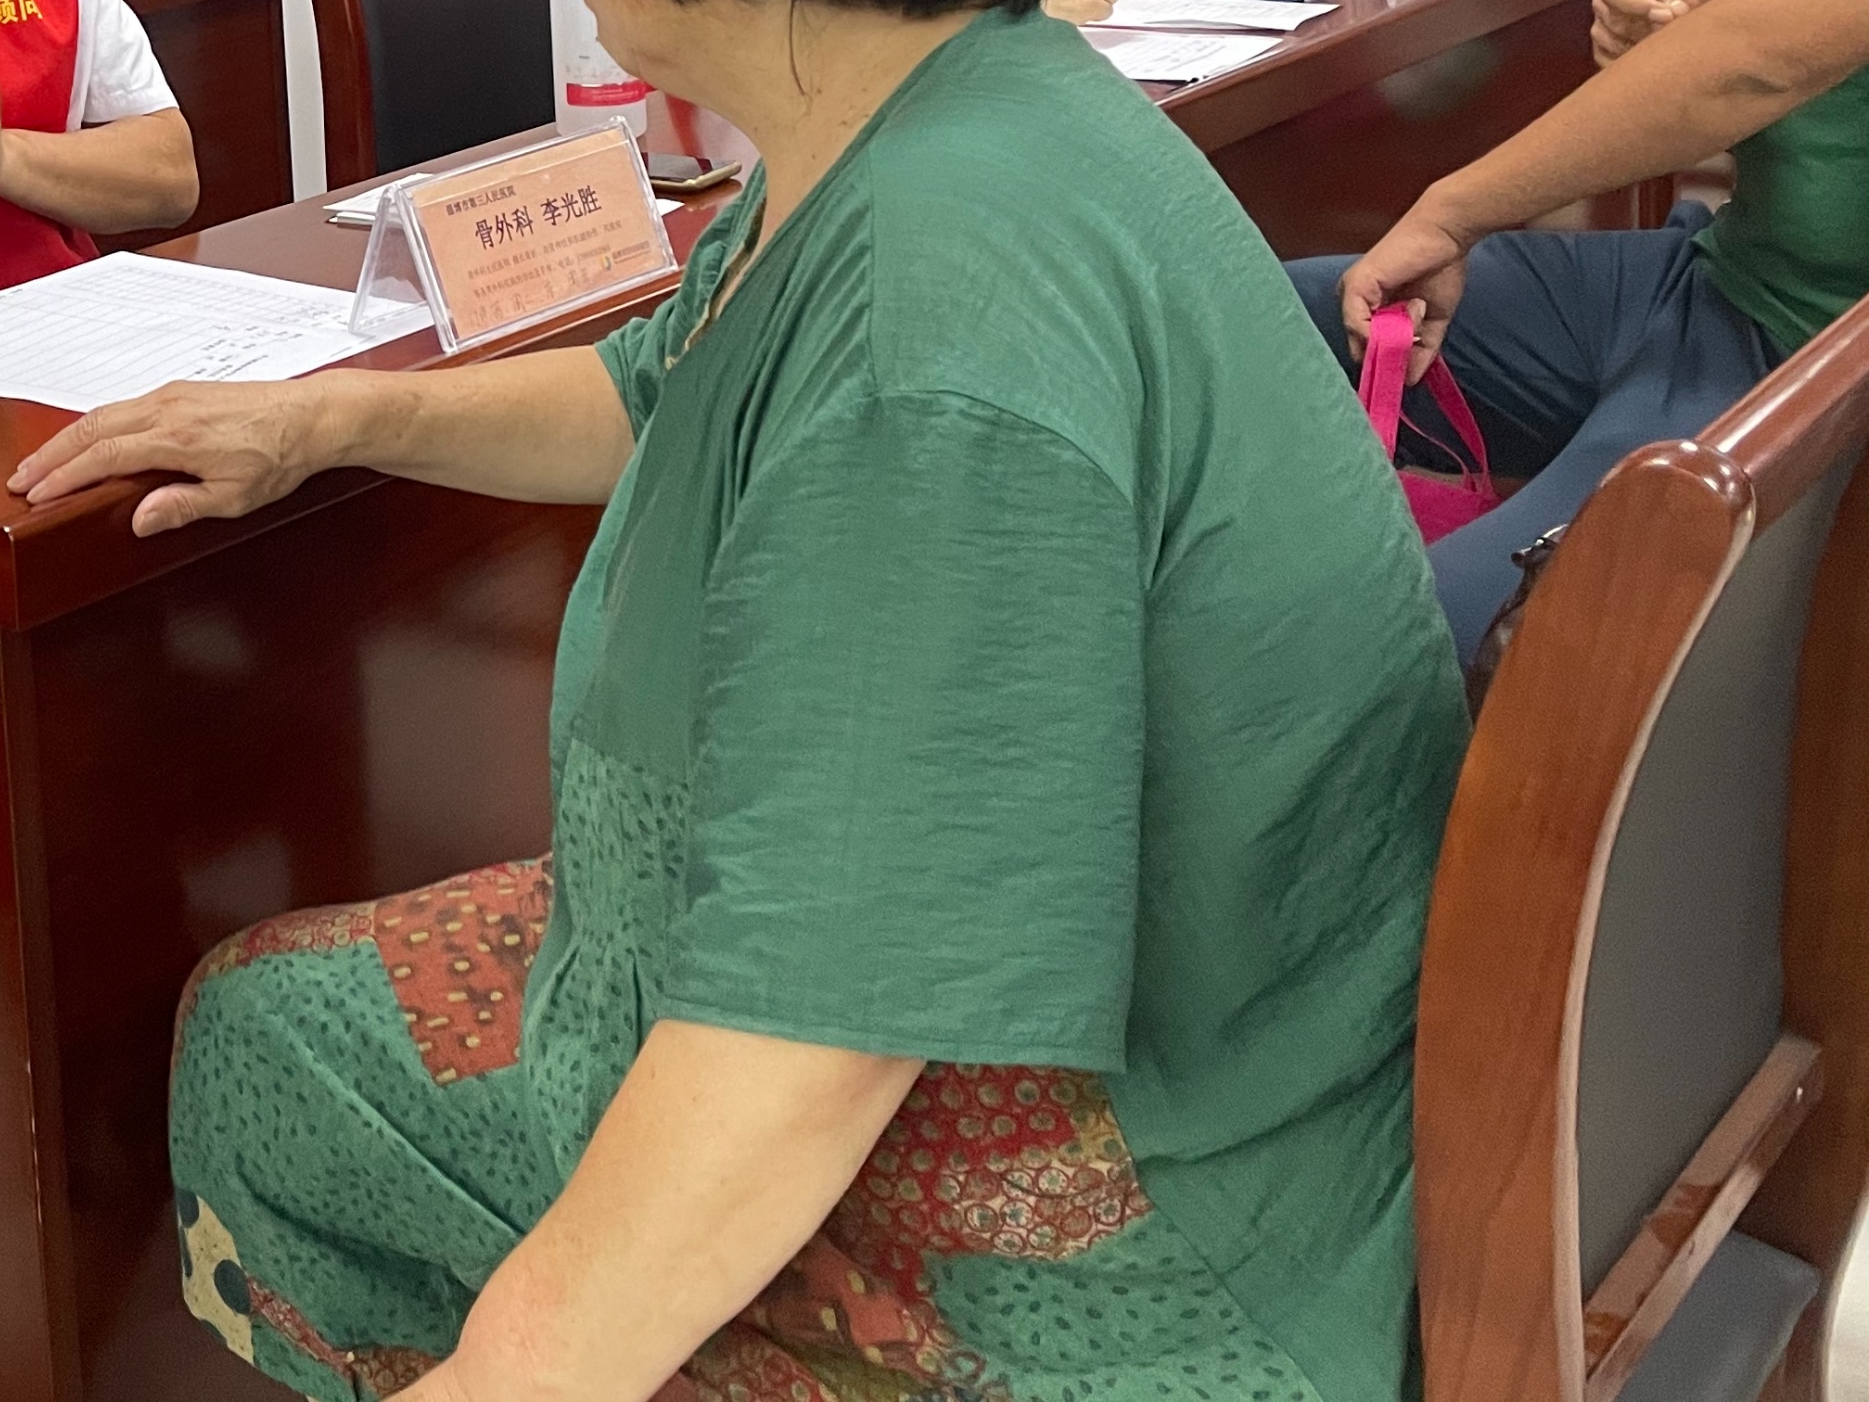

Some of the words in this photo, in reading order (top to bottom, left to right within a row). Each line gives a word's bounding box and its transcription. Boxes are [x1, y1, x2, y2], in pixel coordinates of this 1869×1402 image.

[474, 204, 534, 251] 骨外科
[540, 184, 603, 227] 李光胜
